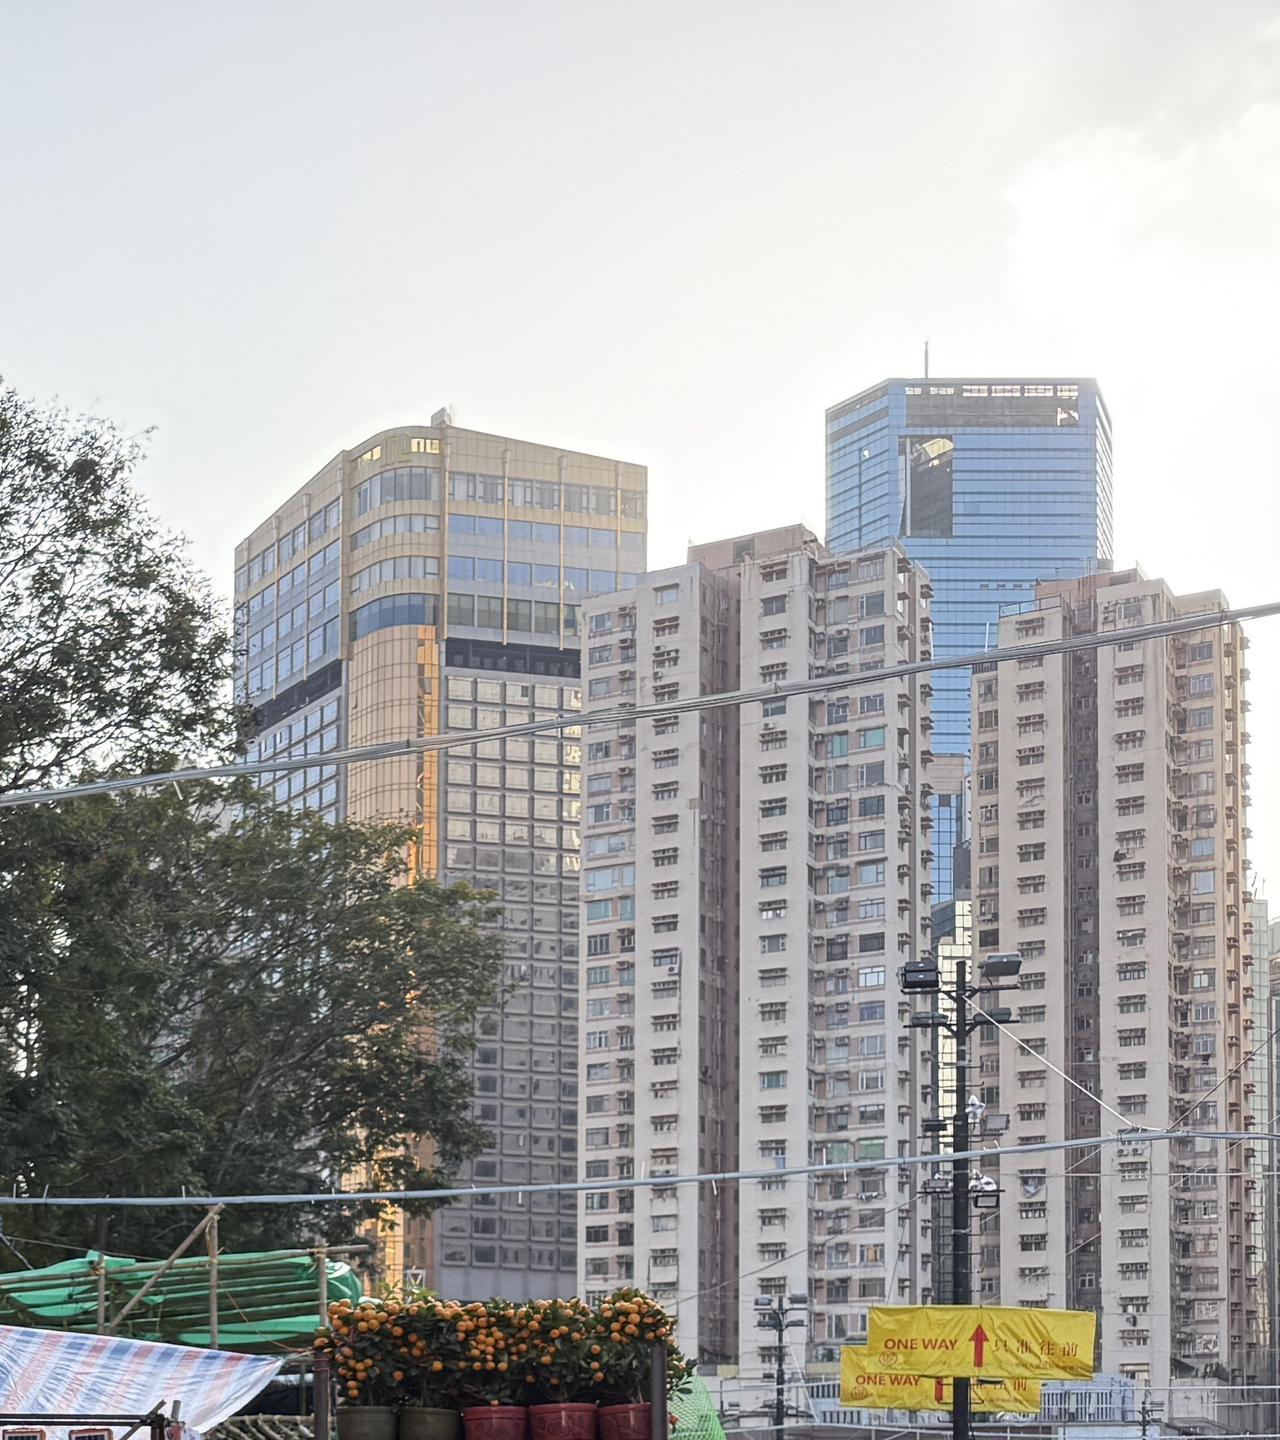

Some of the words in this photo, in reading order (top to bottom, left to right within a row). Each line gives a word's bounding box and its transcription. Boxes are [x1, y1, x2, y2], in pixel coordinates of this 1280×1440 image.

[884, 1338, 918, 1350] ONE
[921, 1338, 959, 1350] WAY
[855, 1374, 887, 1386] ONE
[889, 1374, 921, 1387] WAY
